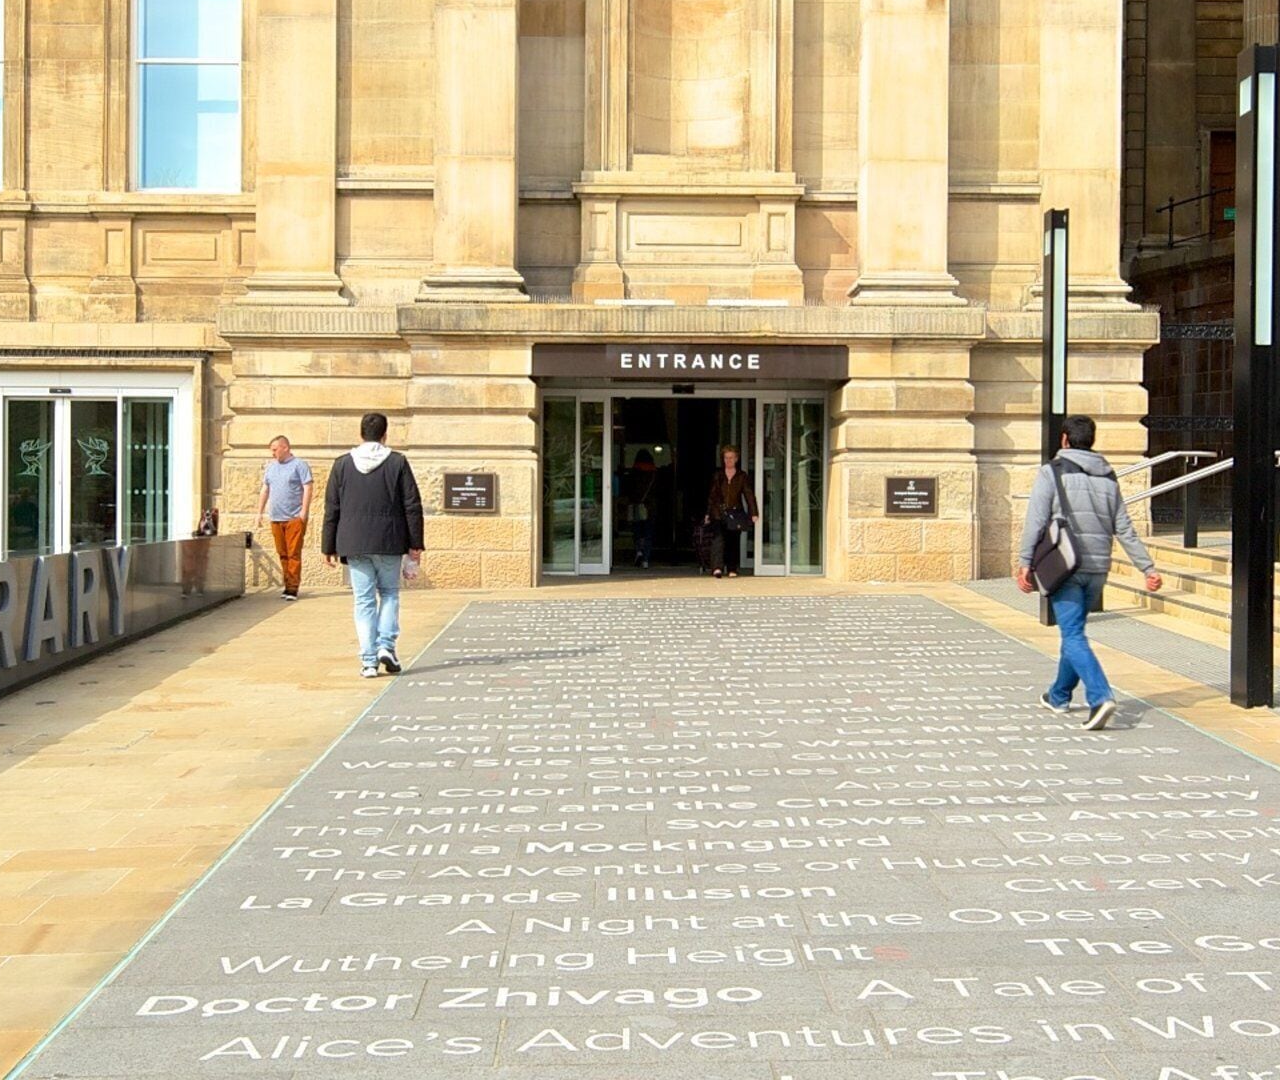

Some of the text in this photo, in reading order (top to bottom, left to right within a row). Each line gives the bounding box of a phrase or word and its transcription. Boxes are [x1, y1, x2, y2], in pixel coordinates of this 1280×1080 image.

[620, 353, 761, 369] ENTRANCE
[753, 695, 1005, 705] Dangreuses
[391, 721, 571, 732] Northern
[841, 715, 965, 723] Divine
[508, 732, 655, 740] Frank's
[673, 730, 779, 738] Diary
[435, 746, 492, 754] All
[508, 744, 629, 753] Quiet
[643, 743, 697, 751] on
[797, 737, 983, 748] Western
[997, 735, 1118, 743] Front
[791, 746, 1181, 761] Gulliver's Travels
[342, 756, 710, 769] West Side Story
[588, 767, 839, 778] Chronicles
[855, 764, 899, 773] of
[914, 763, 1069, 772] Narnia
[328, 783, 752, 800] The Color Purple
[835, 774, 1251, 792] Apocalypse Now
[353, 790, 1260, 816] Charlie and the Chocolate Factory
[285, 821, 605, 836] The Mikado
[667, 816, 926, 829] Swallows
[945, 811, 1047, 823] and
[1013, 831, 1125, 843] Das
[273, 835, 892, 858] To Kill a Mockingbird
[296, 868, 407, 881] The
[428, 862, 782, 878] Adventures
[805, 858, 862, 871] of
[881, 852, 1251, 869] Huckleberry
[240, 885, 838, 909] La Grande Illusion
[445, 907, 1165, 935] A Night at the Opera
[1023, 938, 1174, 956] The
[219, 943, 910, 974] Wuthering Heights
[856, 979, 914, 1000] A
[932, 977, 1107, 997] Tale
[1135, 973, 1209, 994] of
[134, 986, 764, 1017] Doctor Zhivago
[198, 1032, 484, 1061] Alice's
[516, 1026, 1013, 1052] Adventures
[1031, 1019, 1116, 1042] in
